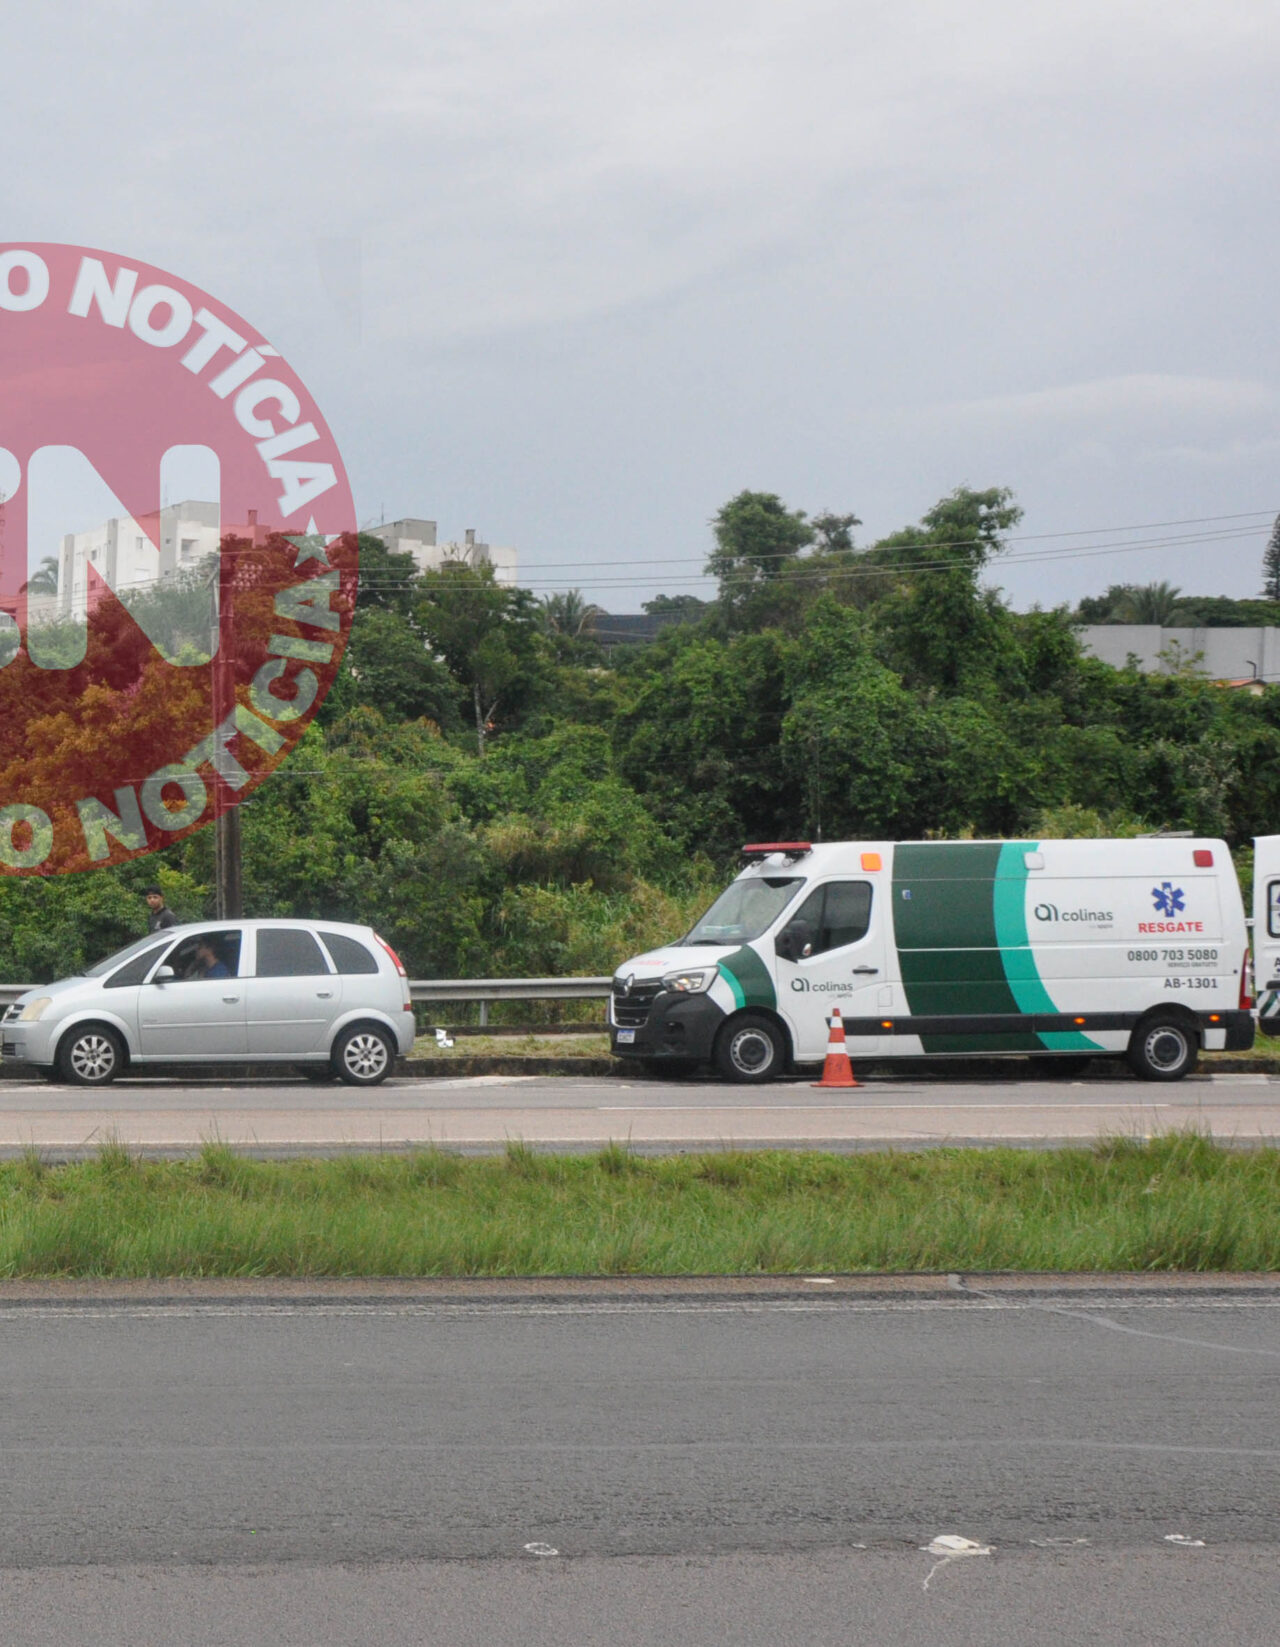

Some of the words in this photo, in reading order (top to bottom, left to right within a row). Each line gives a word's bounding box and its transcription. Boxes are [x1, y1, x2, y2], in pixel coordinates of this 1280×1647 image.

[1061, 908, 1114, 922] colinas
[1138, 921, 1204, 933] RESGATE
[1127, 950, 1158, 961] 0800
[1161, 950, 1184, 961] 703
[1187, 949, 1218, 960] 5080
[812, 982, 853, 992] colinas
[1163, 977, 1218, 989] AB-1301
